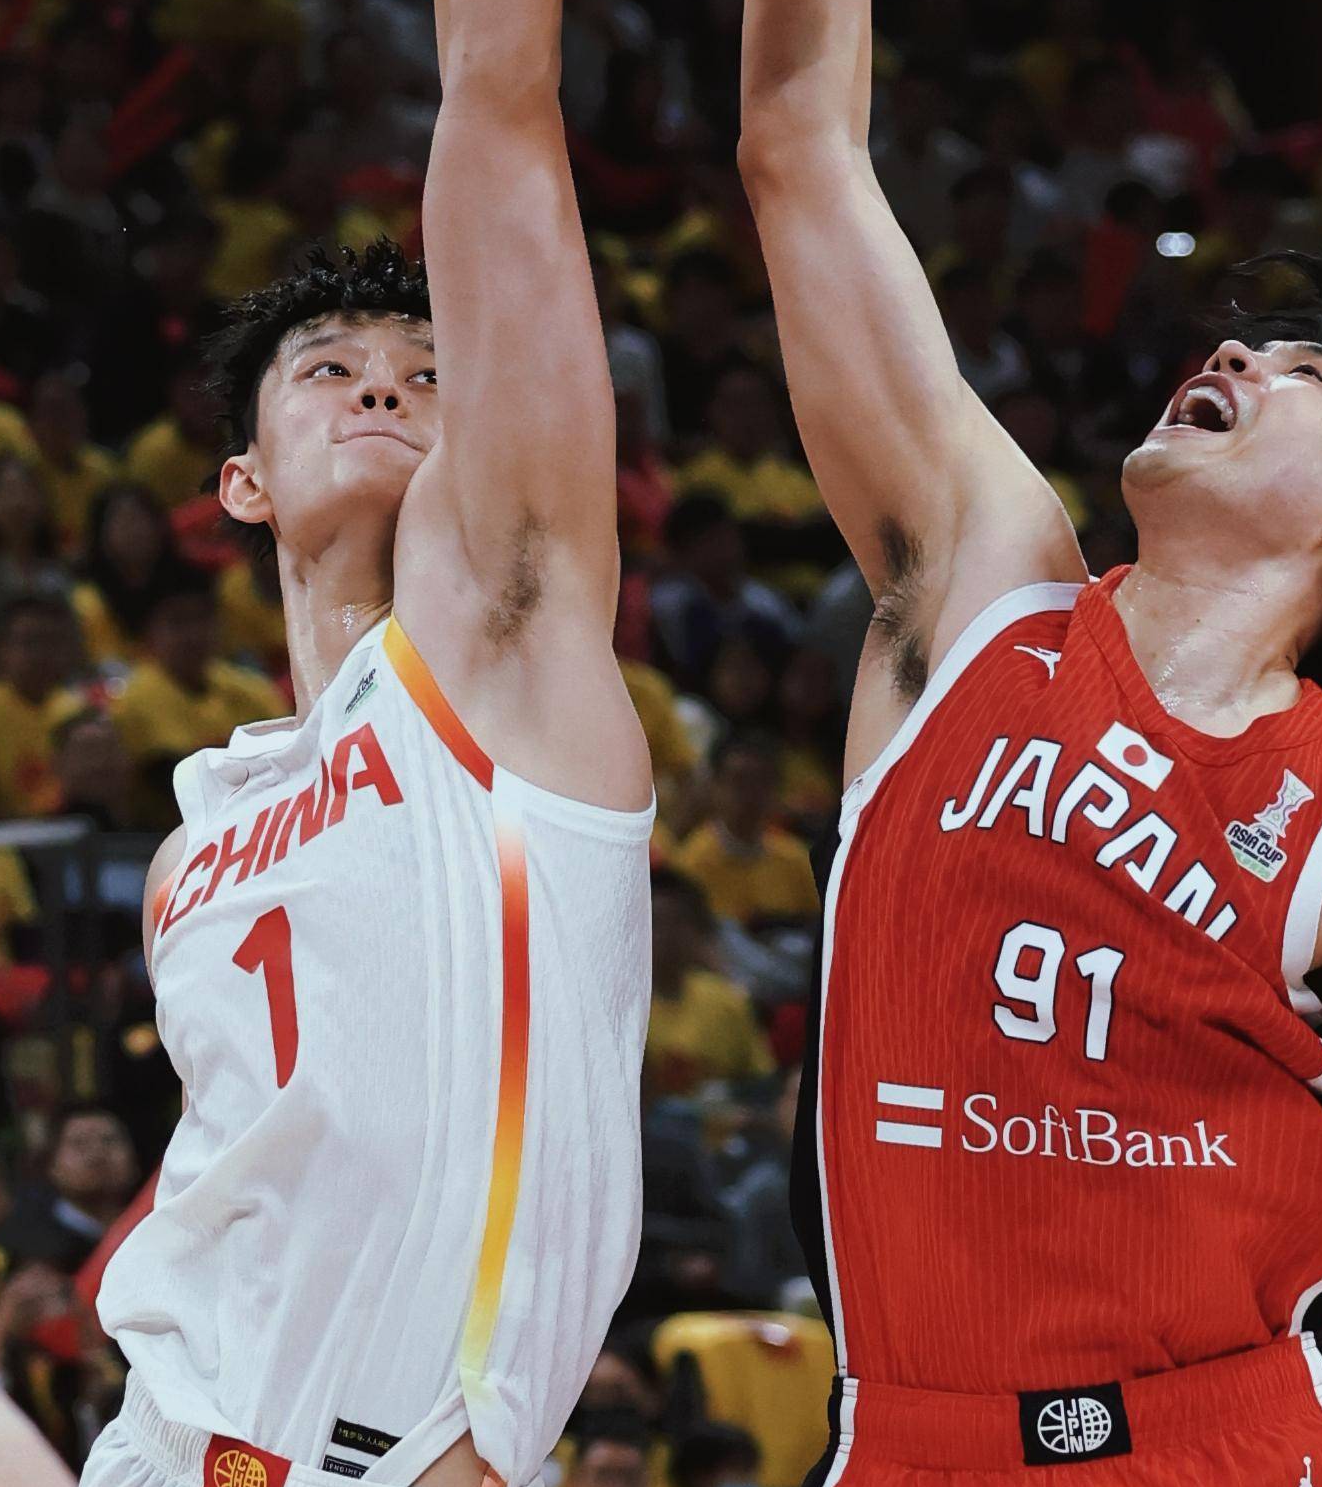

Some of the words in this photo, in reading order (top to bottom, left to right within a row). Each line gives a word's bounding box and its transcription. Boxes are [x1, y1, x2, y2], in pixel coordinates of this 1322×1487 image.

[160, 722, 404, 940] CHINA
[939, 737, 1238, 944] JAPAN
[1228, 824, 1259, 849] ASIA
[1257, 842, 1284, 863] CUP
[232, 905, 300, 1090] 1
[991, 921, 1126, 1063] 91
[960, 1093, 1237, 1169] SoftBank
[1066, 1398, 1084, 1454] JPN
